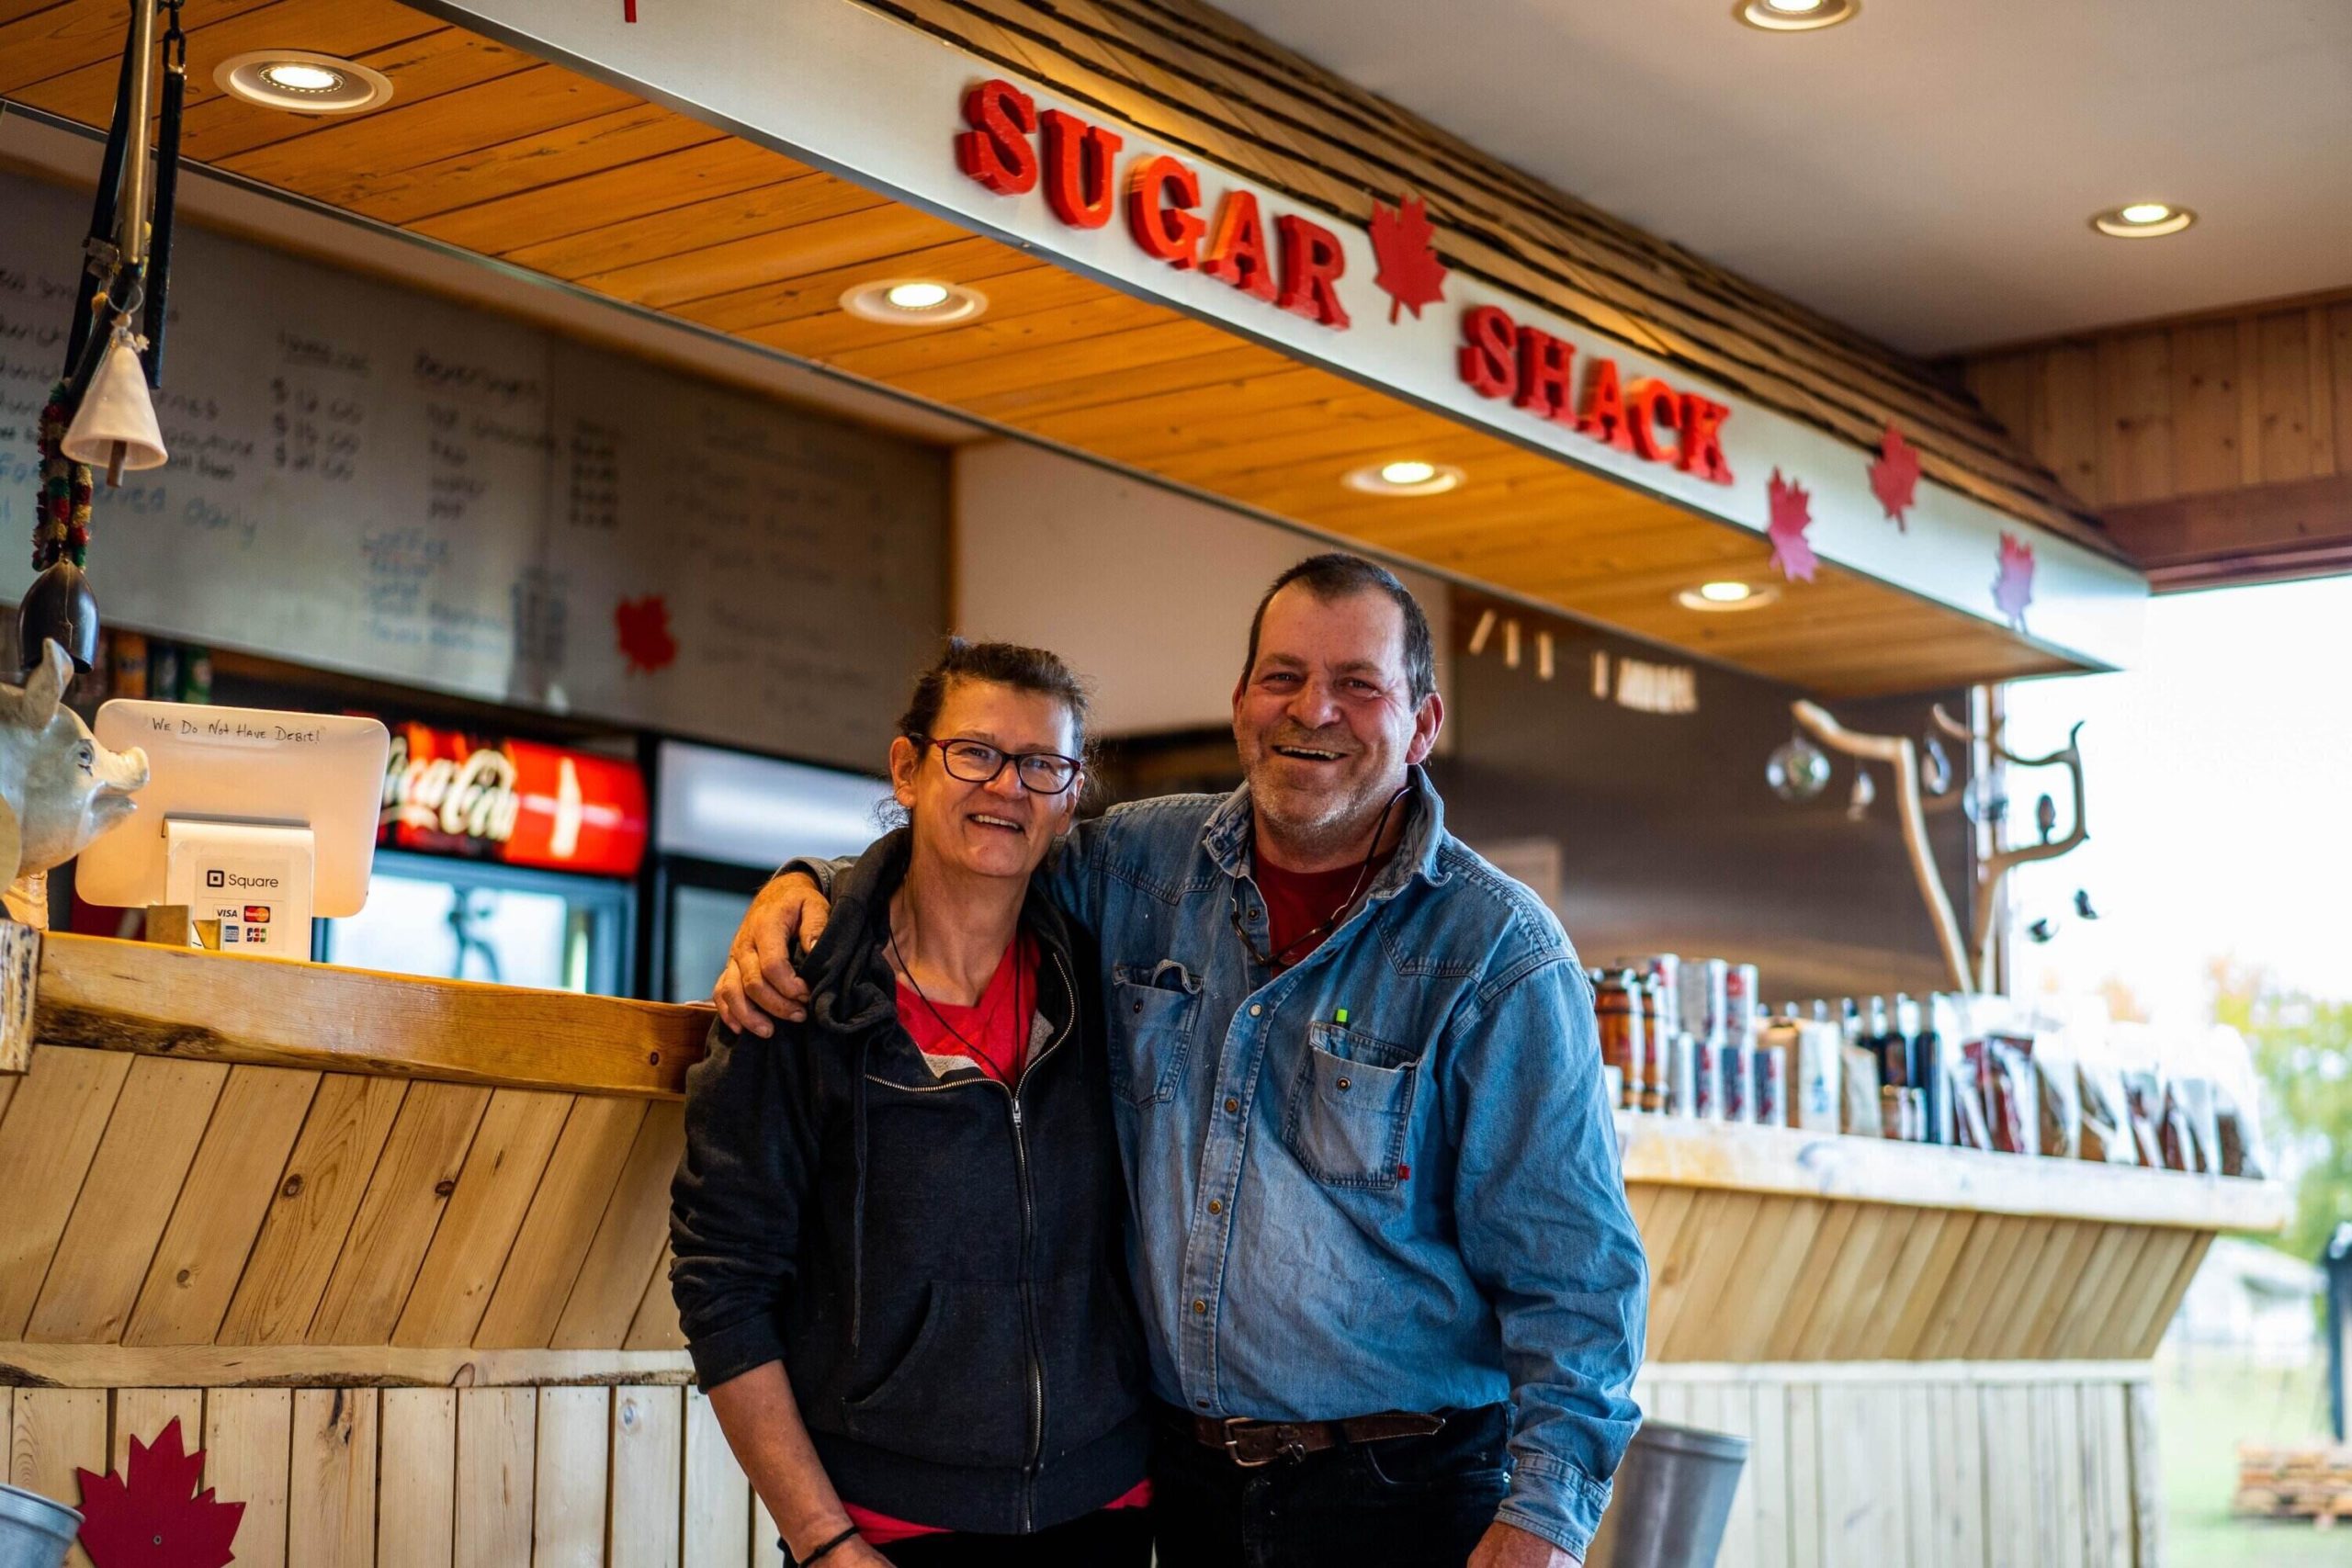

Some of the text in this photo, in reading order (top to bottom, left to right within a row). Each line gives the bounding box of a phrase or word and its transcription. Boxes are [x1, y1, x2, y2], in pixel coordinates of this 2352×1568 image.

[956, 78, 1734, 485] SUGAR SHACK
[228, 874, 279, 889] Square
[217, 908, 238, 918] VISA
